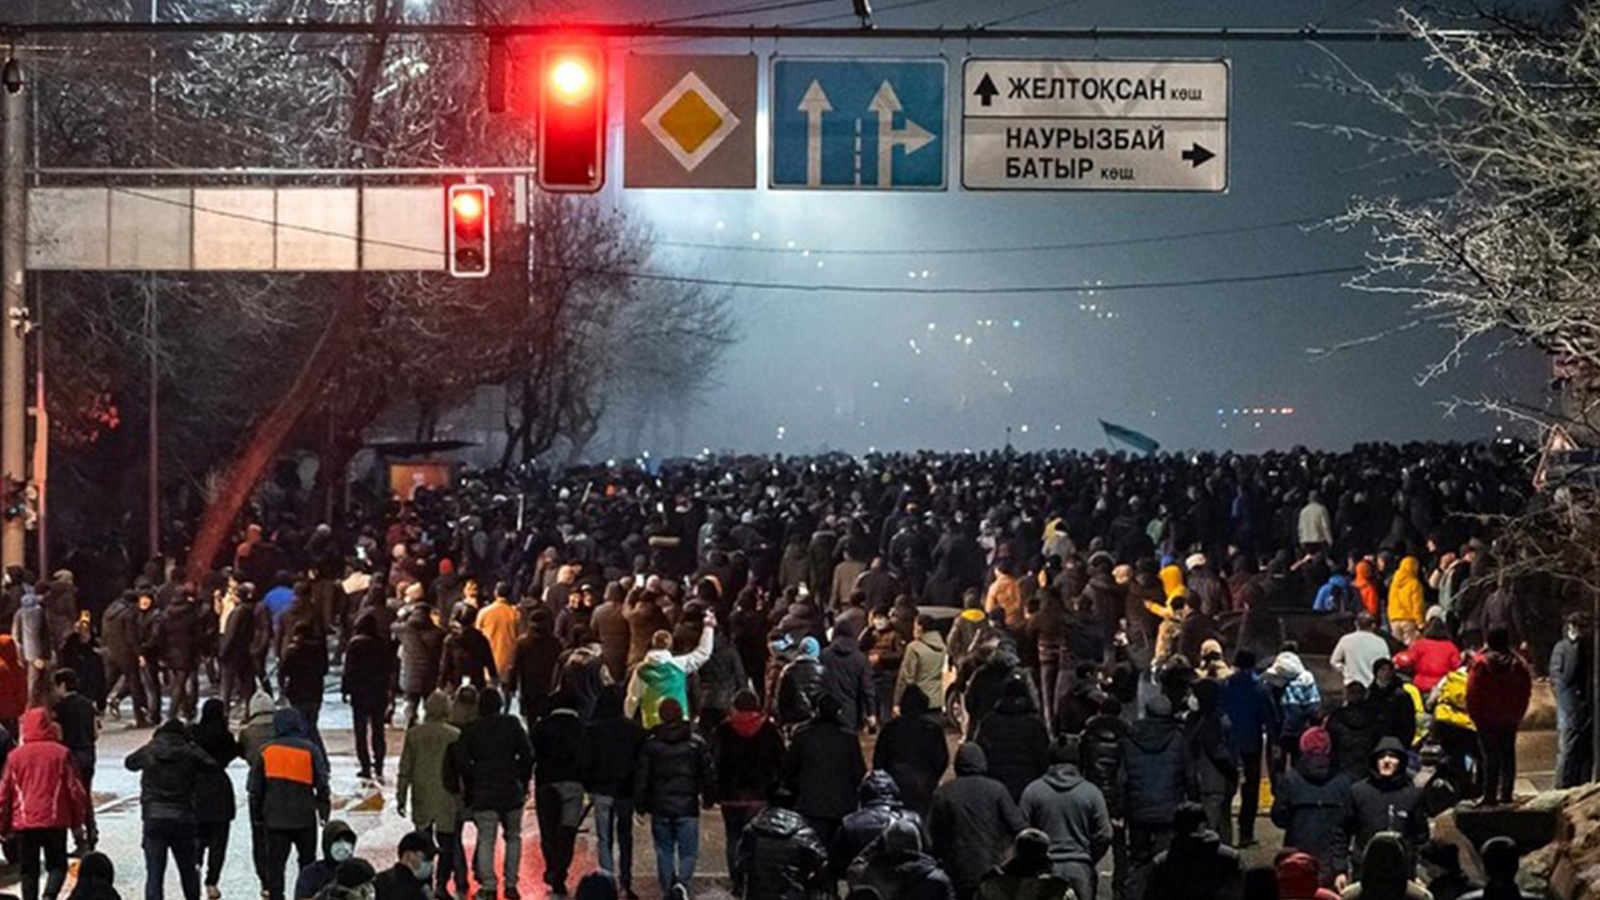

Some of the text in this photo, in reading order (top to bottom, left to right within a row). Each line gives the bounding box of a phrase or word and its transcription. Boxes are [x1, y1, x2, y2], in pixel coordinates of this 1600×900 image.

[1007, 77, 1166, 102] ЖЕЛТОҚСАН
[1006, 124, 1165, 150] НАУРЫЗБАЙ
[1006, 157, 1094, 179] БАТЫР
